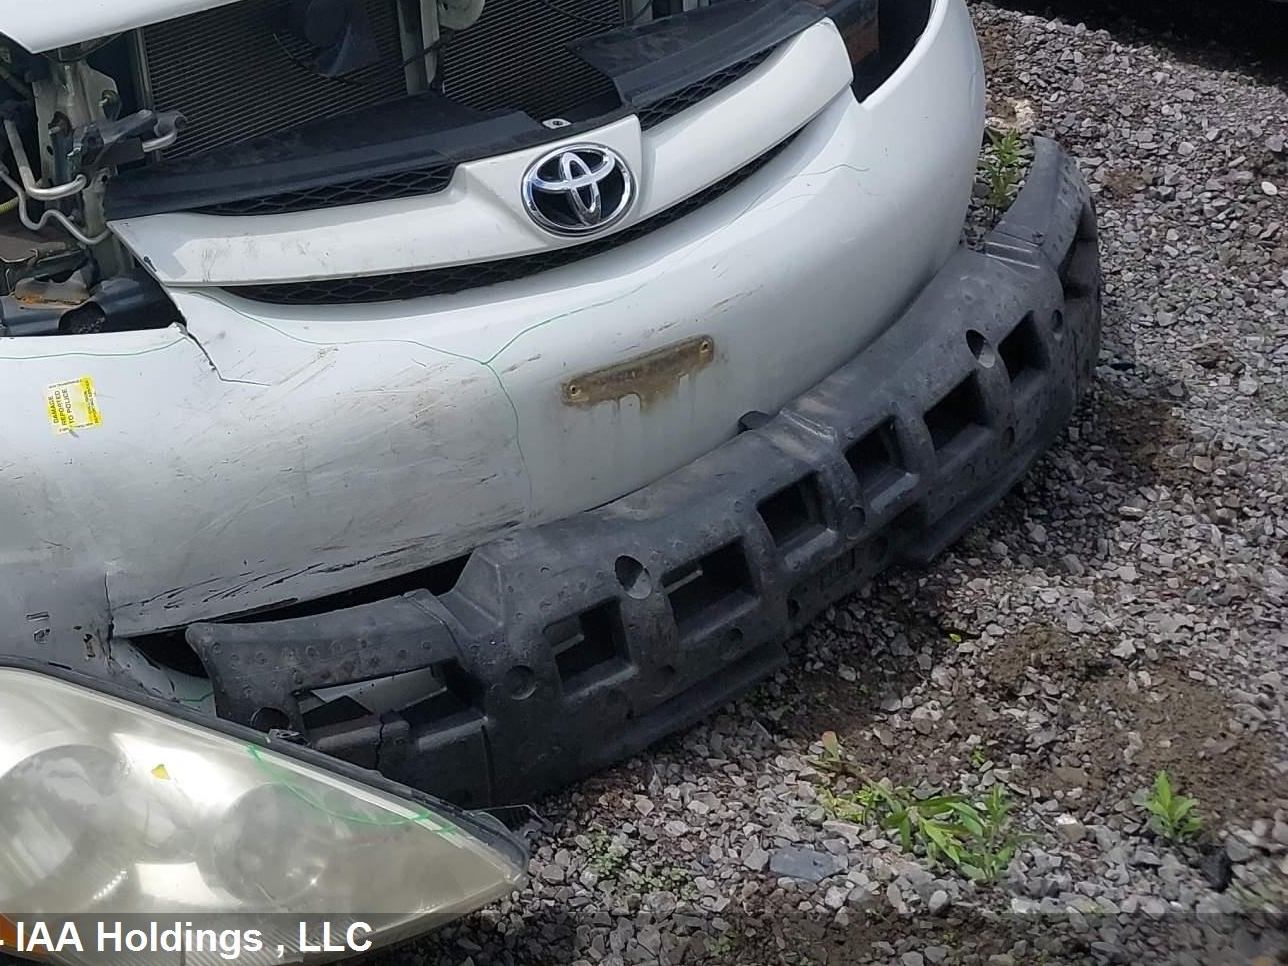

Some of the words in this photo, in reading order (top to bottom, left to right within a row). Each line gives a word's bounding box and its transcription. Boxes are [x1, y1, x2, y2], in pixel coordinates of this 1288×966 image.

[48, 396, 59, 424] DAMAGE
[55, 390, 67, 425] REPORTED
[62, 388, 71, 414] POLICE
[68, 415, 74, 424] TO
